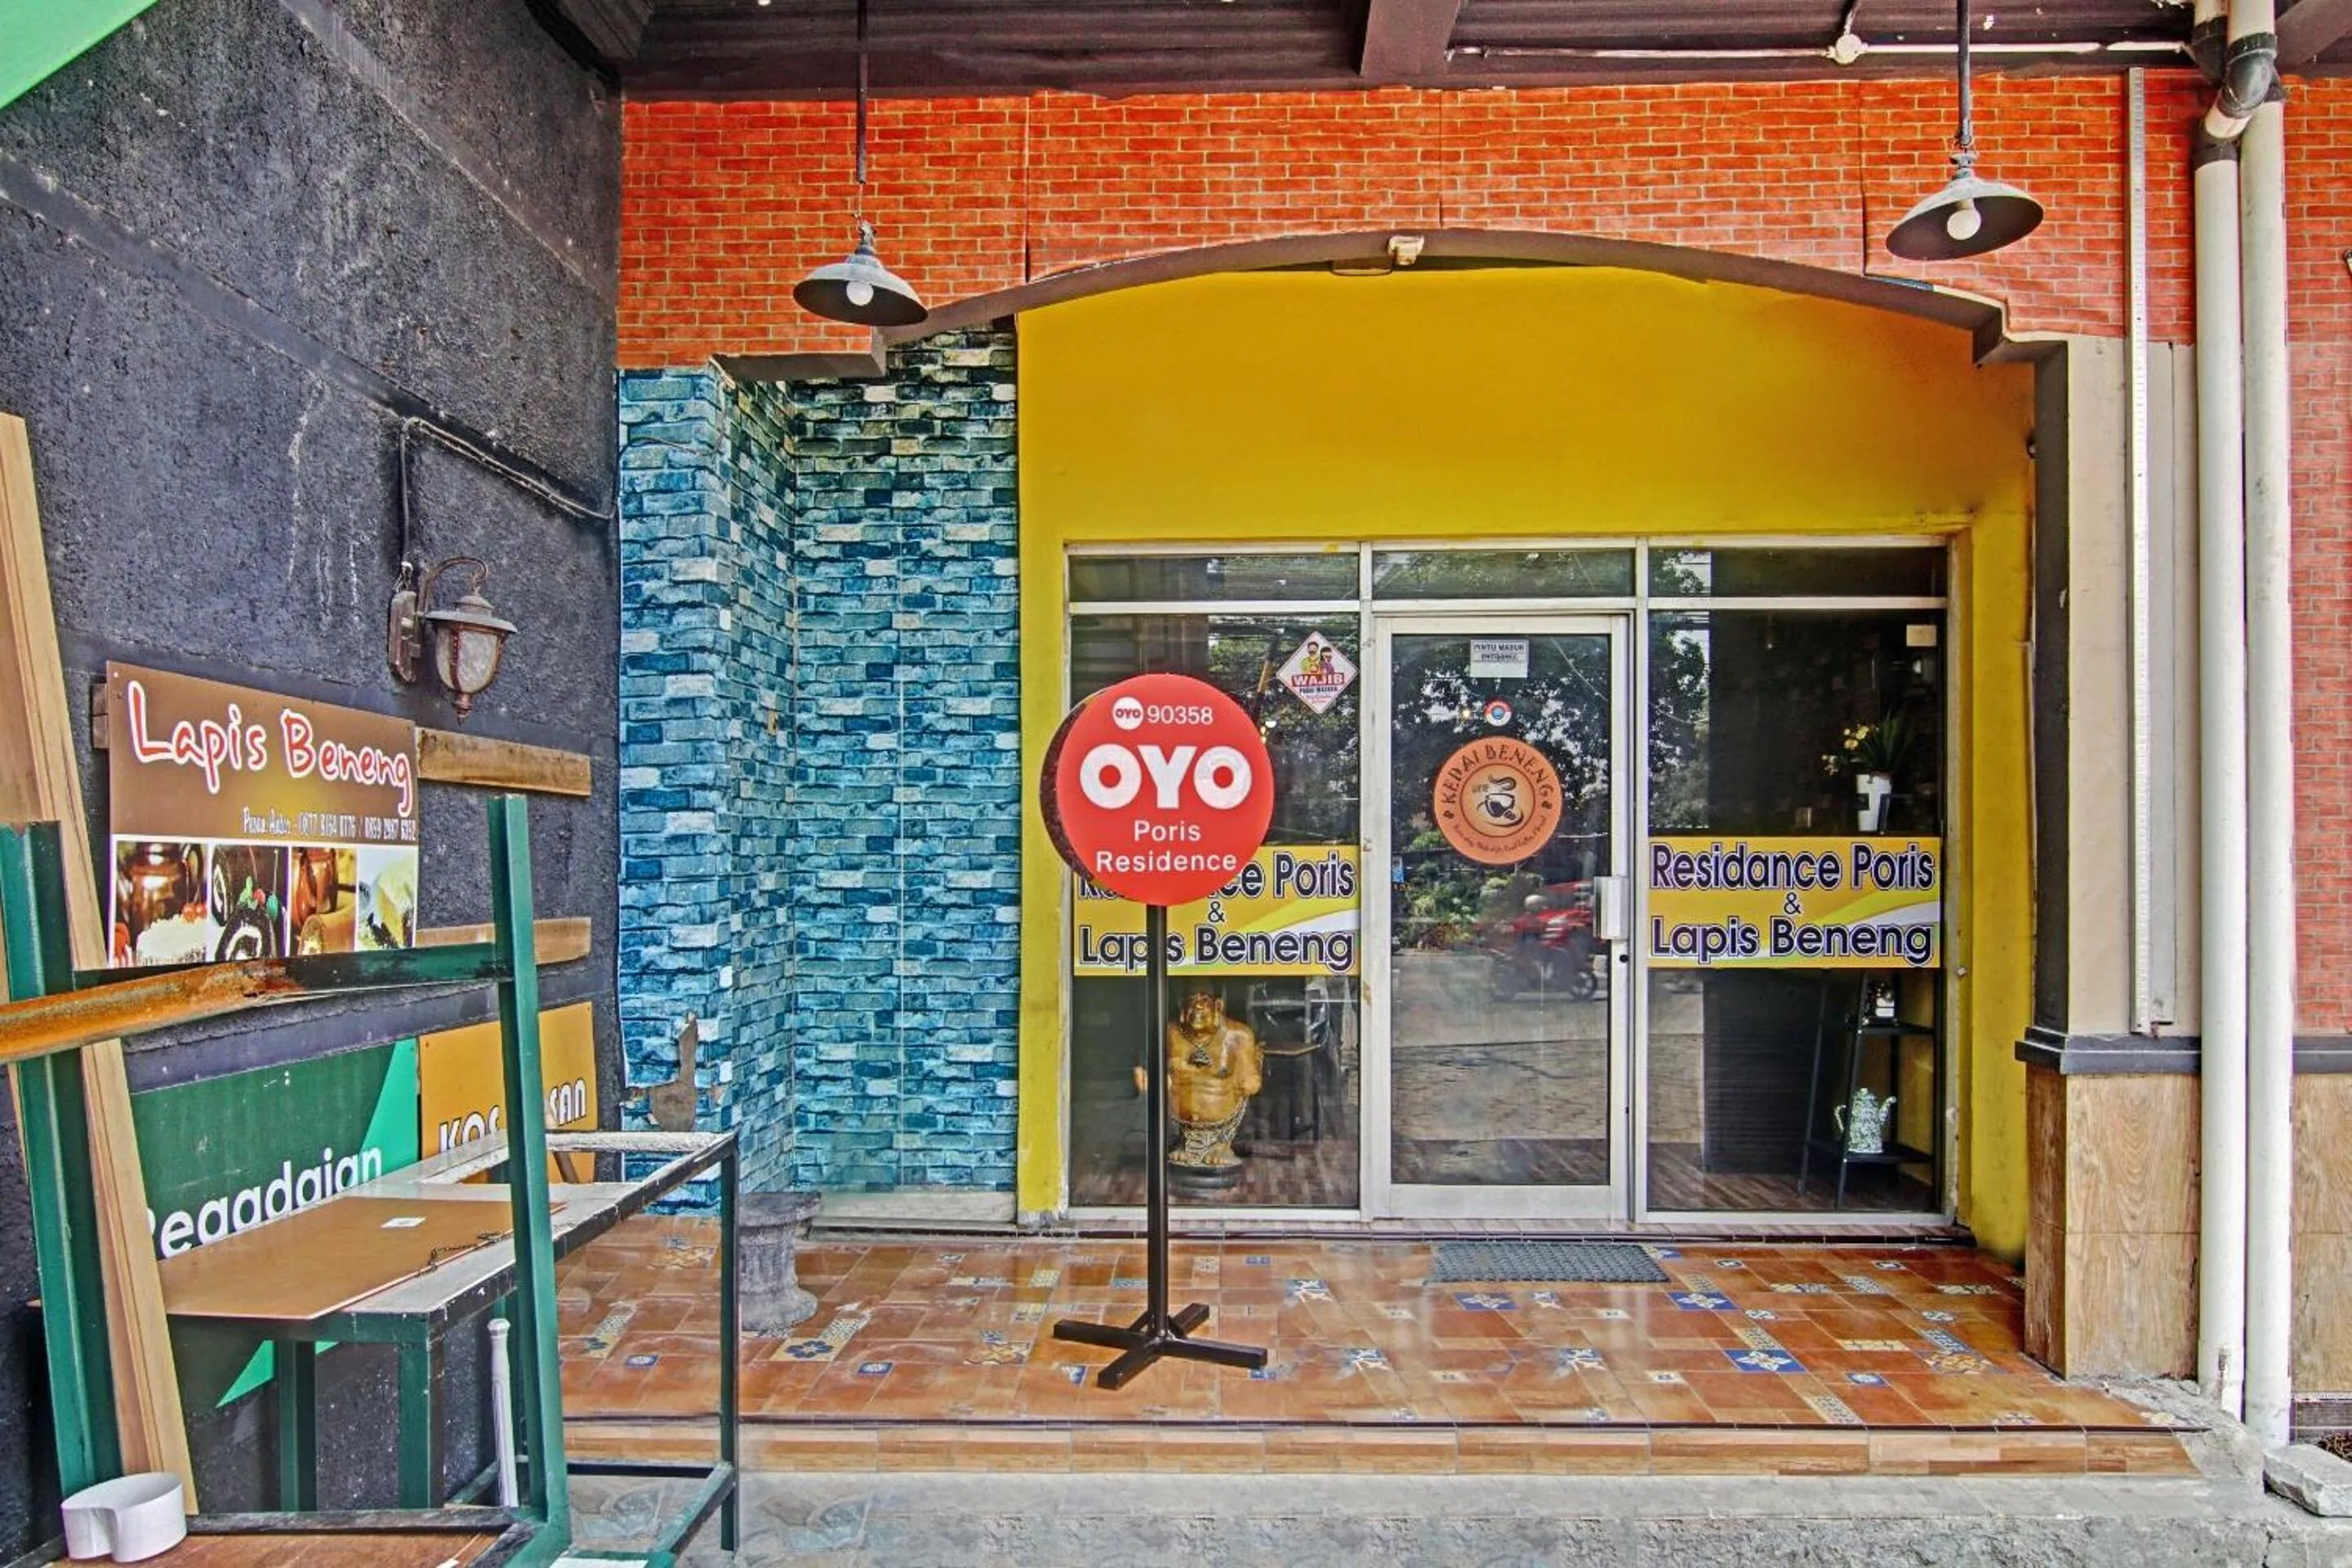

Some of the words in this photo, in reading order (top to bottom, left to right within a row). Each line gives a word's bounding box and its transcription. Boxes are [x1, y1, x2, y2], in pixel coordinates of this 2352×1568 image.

[1293, 674, 1343, 686] WAJIB
[1116, 707, 1143, 719] OYO
[1147, 705, 1214, 725] 90358
[127, 680, 268, 795] Lapis
[281, 707, 412, 817] Beneng
[1080, 743, 1253, 810] OYO
[1441, 751, 1481, 804] KEDAI
[1485, 744, 1554, 797] BENENG
[1134, 820, 1202, 842] Poris
[1095, 851, 1238, 873] Residence
[1273, 850, 1357, 899] Poris
[1650, 842, 1843, 891] Residance
[1851, 842, 1936, 891] Poris
[1208, 901, 1225, 923] &
[1783, 892, 1802, 915] &
[1080, 924, 1187, 973] Laps
[1195, 923, 1356, 973] Beneng
[1650, 915, 1762, 965] Lapis
[1770, 915, 1935, 967] Beneng
